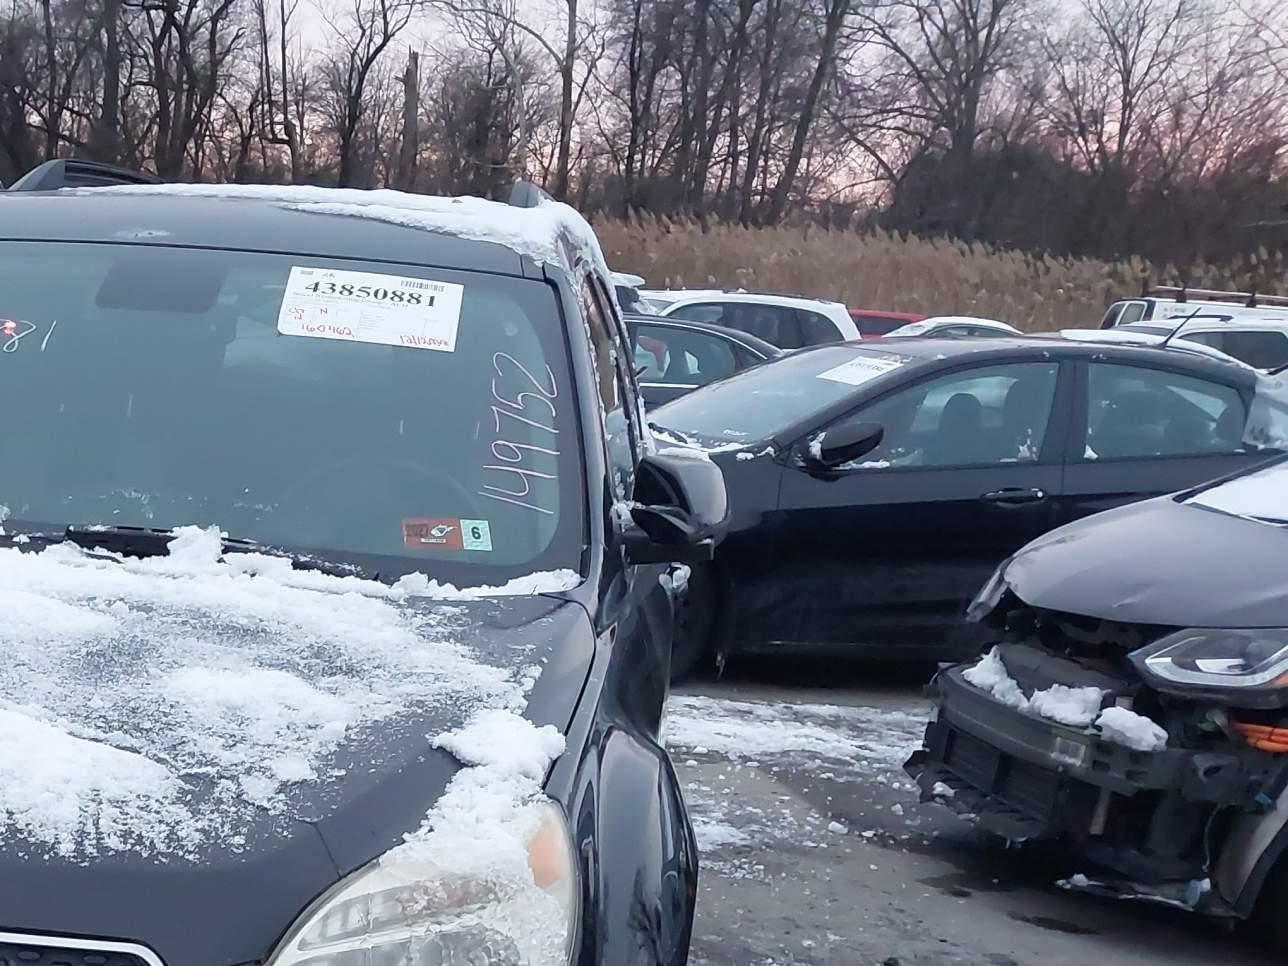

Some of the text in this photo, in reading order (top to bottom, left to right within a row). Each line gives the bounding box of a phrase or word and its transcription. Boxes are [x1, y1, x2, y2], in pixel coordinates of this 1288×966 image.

[304, 280, 437, 308] 43850881
[477, 352, 561, 514] 149752
[470, 526, 482, 540] 6
